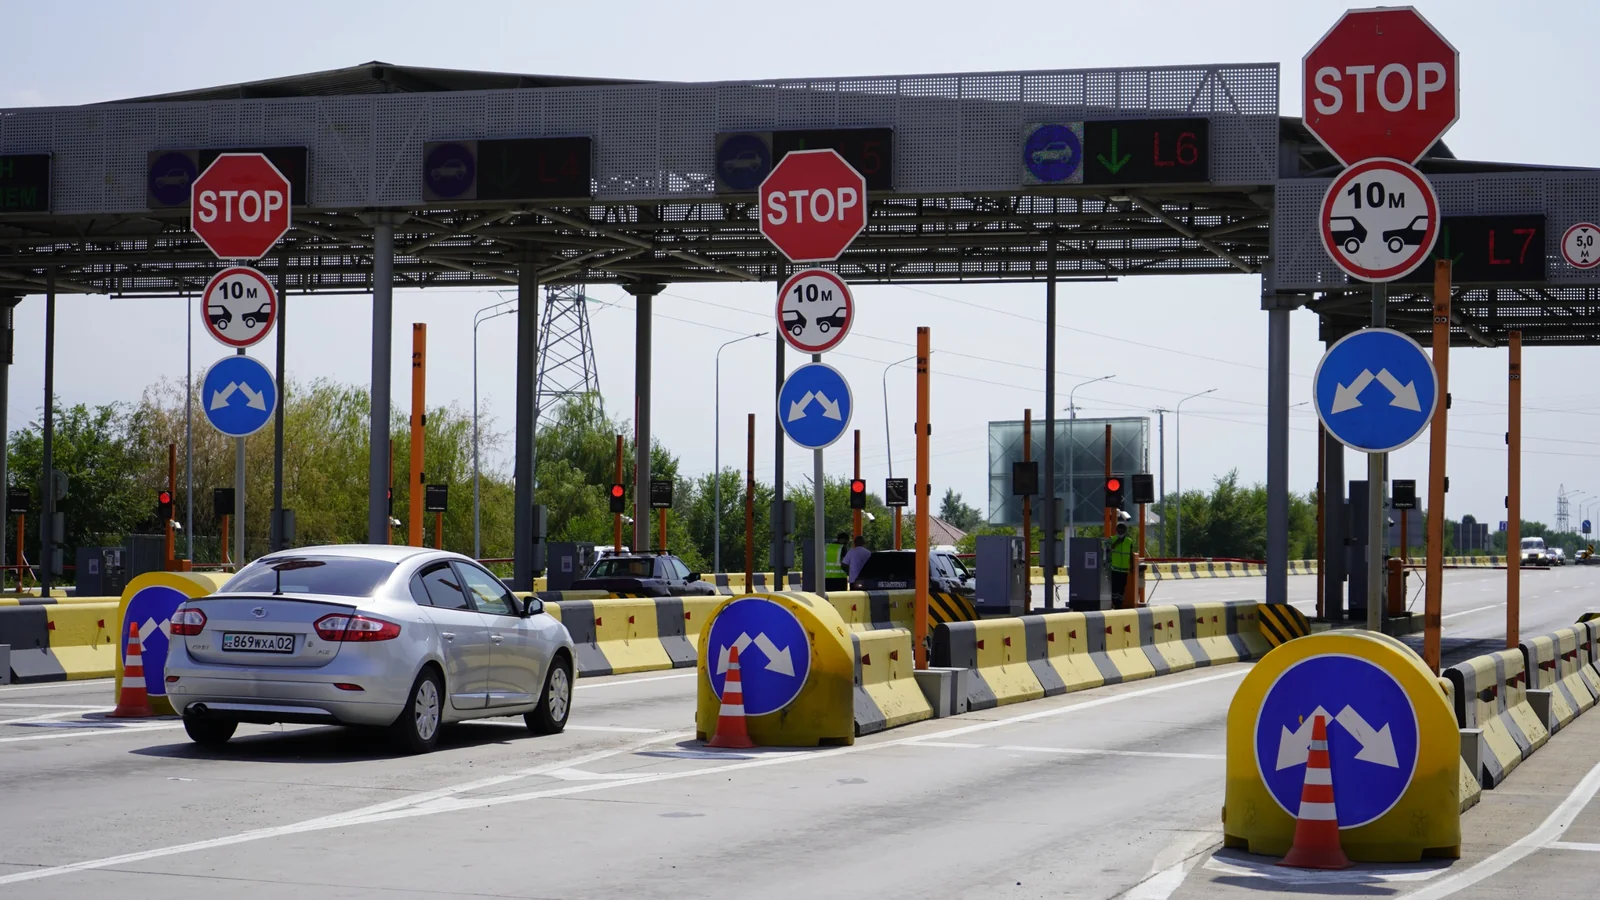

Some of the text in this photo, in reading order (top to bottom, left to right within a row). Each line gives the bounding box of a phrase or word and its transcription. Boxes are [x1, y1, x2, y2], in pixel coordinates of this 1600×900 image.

[1313, 62, 1447, 115] STOP
[538, 149, 580, 184] L4
[1153, 132, 1198, 167] L6
[198, 190, 283, 223] STOP
[767, 187, 858, 225] STOP
[1488, 228, 1536, 265] L7
[1576, 235, 1594, 249] 5,0
[233, 636, 292, 650] 869WXA 02
